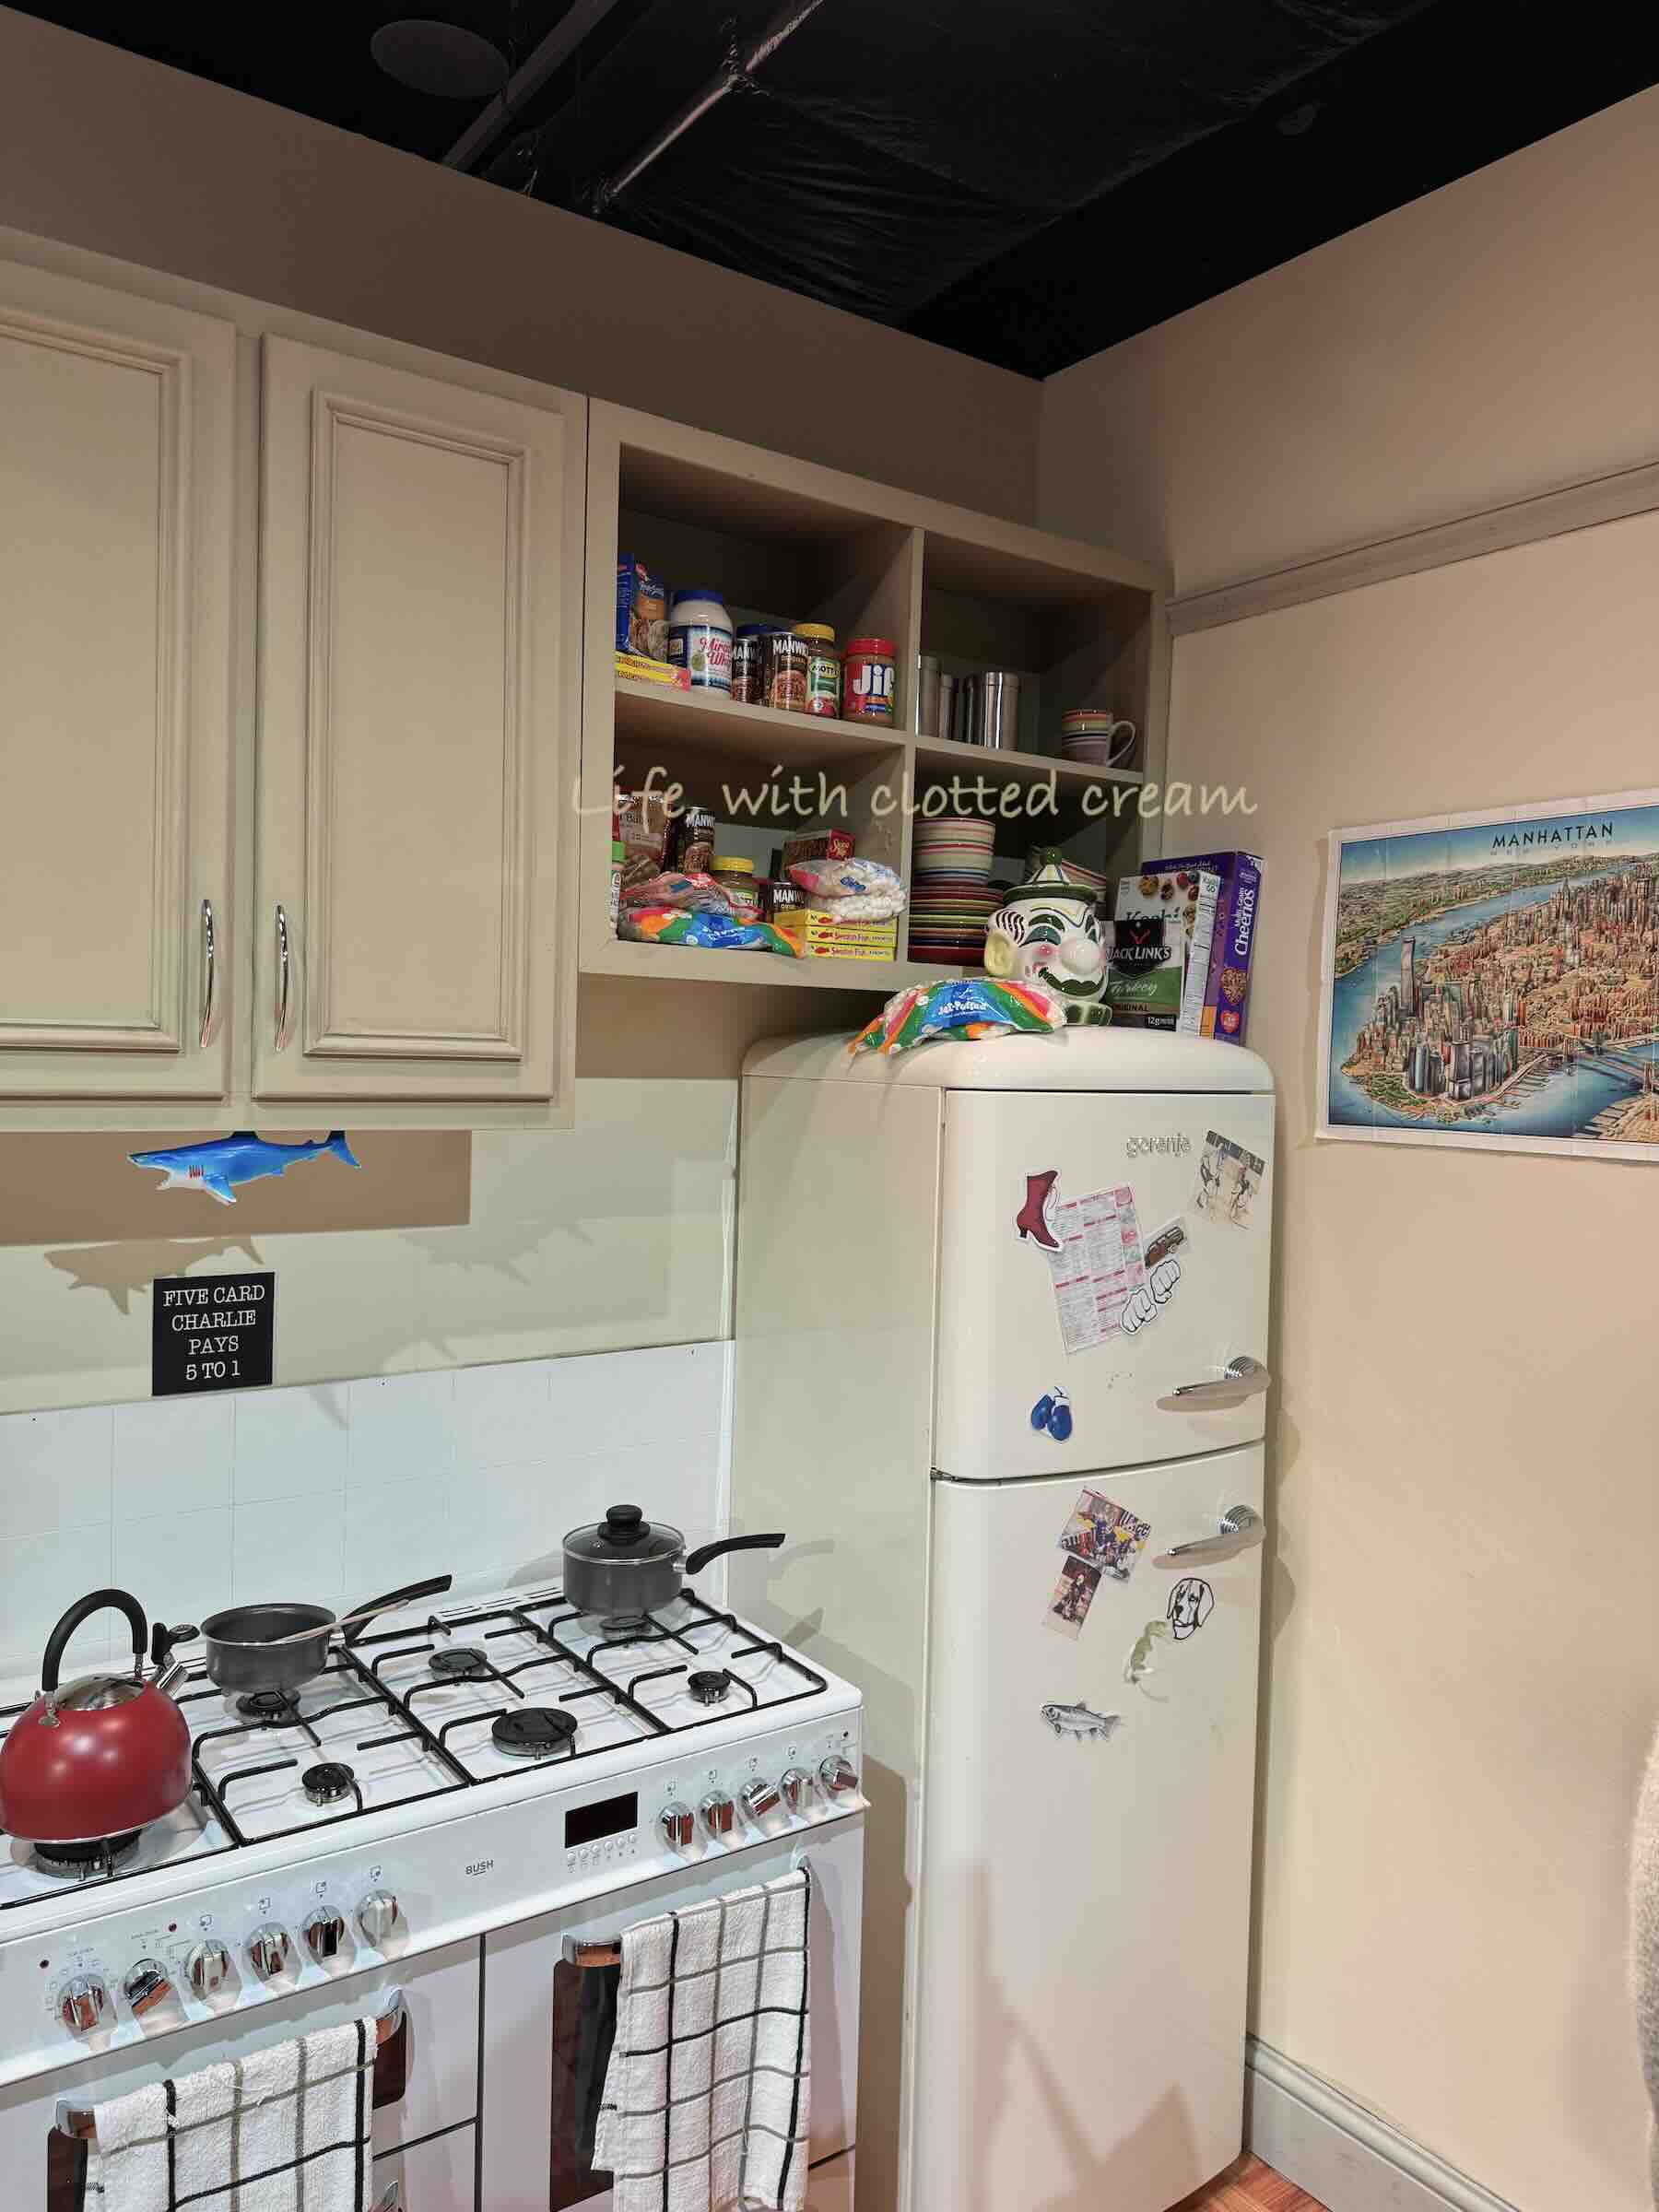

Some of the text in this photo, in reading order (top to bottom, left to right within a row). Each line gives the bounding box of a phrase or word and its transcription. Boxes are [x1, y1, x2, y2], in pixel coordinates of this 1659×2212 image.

[1492, 821, 1613, 849] MANHATTAN
[1233, 888, 1254, 957] Cheerios
[162, 1284, 265, 1307] FIVE CARD
[171, 1309, 256, 1332] CHARLIE
[188, 1335, 240, 1356] PAYS
[185, 1359, 241, 1381] 5 TO 1
[465, 1859, 494, 1876] BUSH
